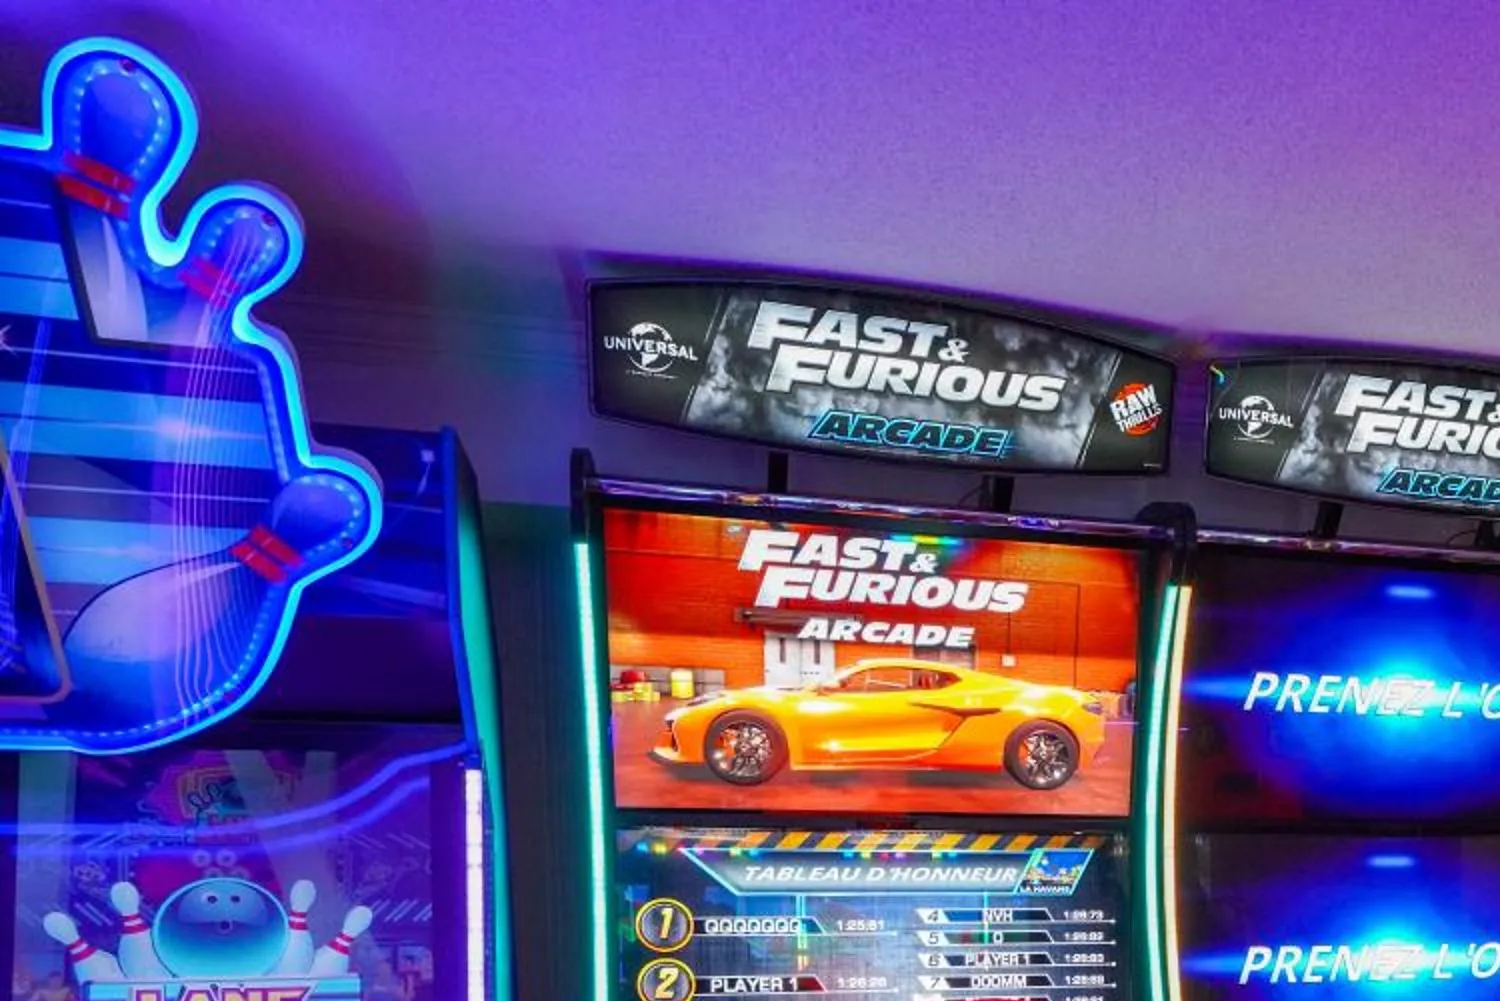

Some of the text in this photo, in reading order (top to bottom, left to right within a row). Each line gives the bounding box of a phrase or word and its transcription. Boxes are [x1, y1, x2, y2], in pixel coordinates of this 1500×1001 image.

[603, 335, 699, 361] UNIVERSAL
[747, 301, 970, 364] FAST &
[764, 347, 1069, 412] FURIOUS
[1334, 374, 1499, 422] FAST
[1110, 384, 1157, 423] RAW
[1218, 407, 1295, 429] UNIVERSAL
[808, 411, 1013, 457] ARCADE
[737, 530, 939, 574] FAST &
[754, 568, 1029, 613] FURIOUS
[798, 618, 976, 648] ARCADE
[1243, 671, 1435, 717] PRENEZ
[744, 866, 1019, 882] TABLEAU D'HONNEUR
[660, 908, 674, 939] 1
[928, 934, 939, 944] 5
[965, 954, 1018, 967] PLAYER
[1239, 944, 1422, 985] PRENEZ
[655, 967, 679, 999] 2
[711, 978, 783, 992] PLAYER
[789, 978, 798, 991] 1
